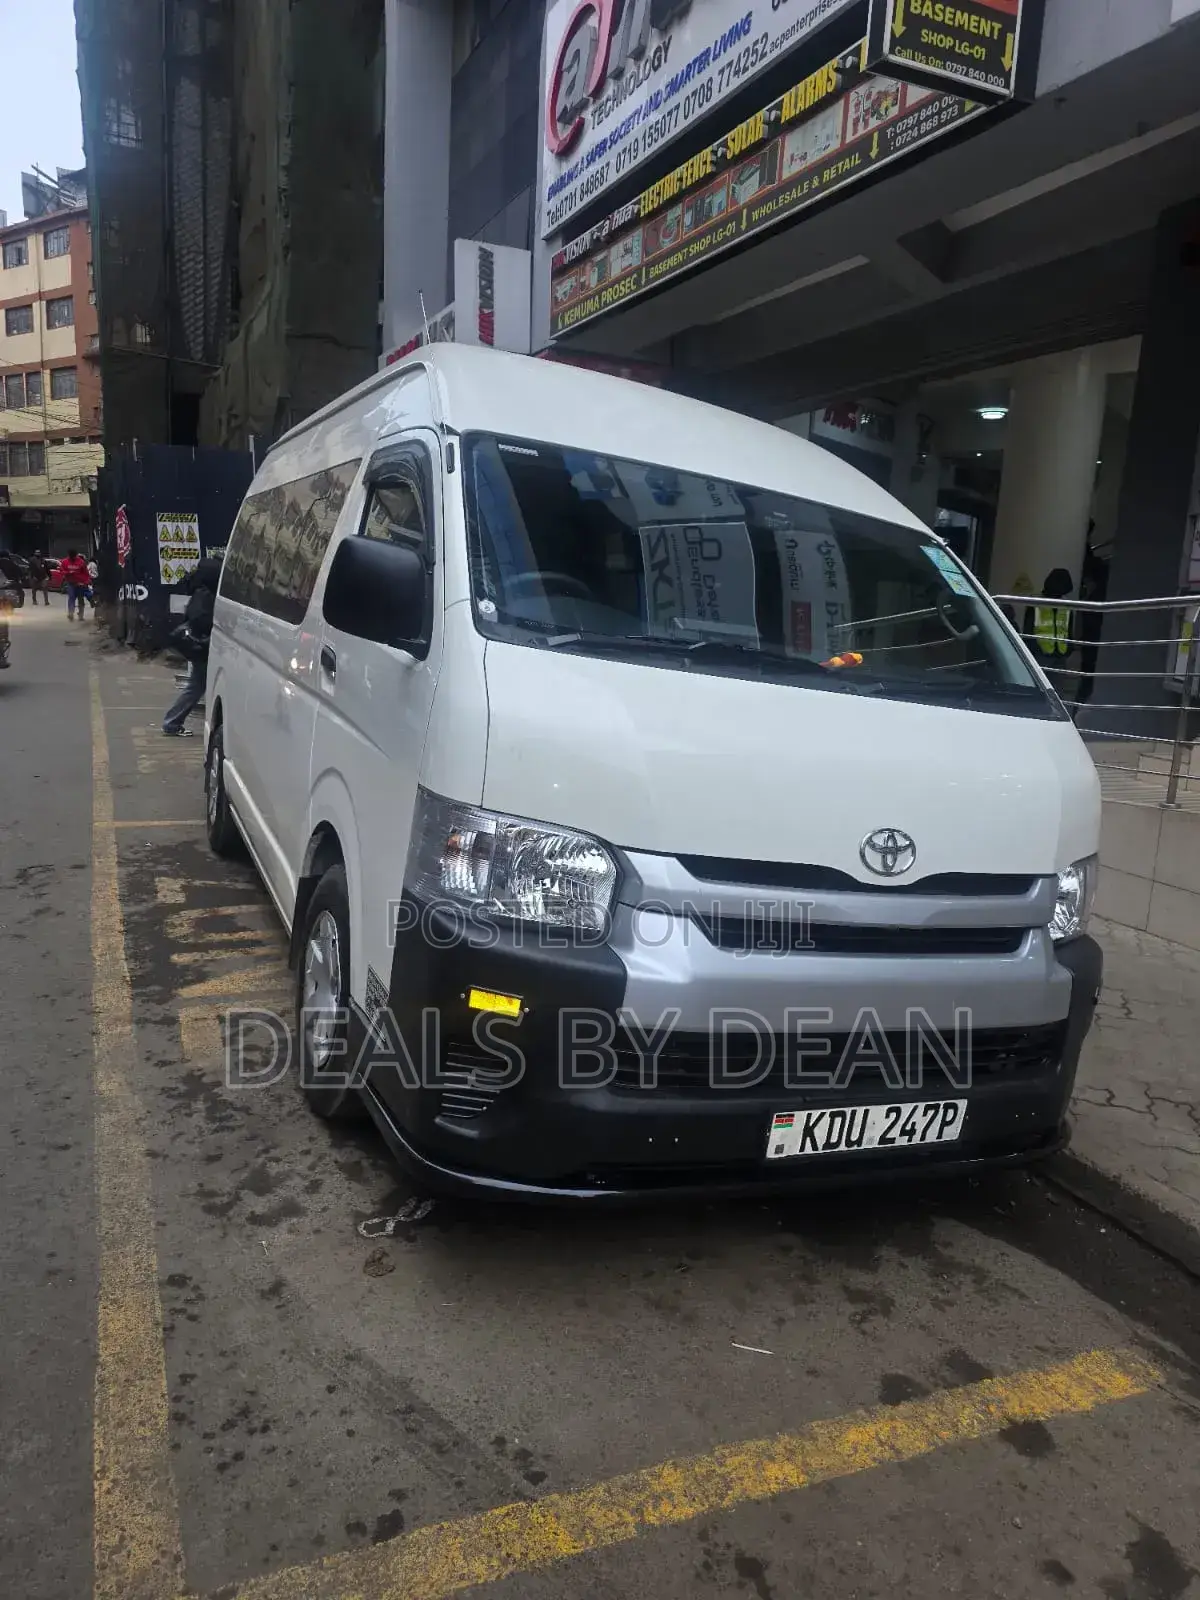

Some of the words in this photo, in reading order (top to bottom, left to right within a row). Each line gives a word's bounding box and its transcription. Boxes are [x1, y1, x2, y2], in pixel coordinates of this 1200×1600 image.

[909, 0, 1002, 40] BASEMENT
[920, 28, 954, 49] SHOP
[955, 39, 986, 61] LG-01
[591, 34, 672, 130] TECHNOLOGY
[608, 104, 643, 150] SOCIETY
[642, 89, 663, 121] AND
[663, 46, 712, 103] SMARTER
[711, 10, 753, 62] LIVING
[894, 46, 913, 59] Call
[914, 51, 926, 62] Us
[928, 55, 944, 69] On:
[945, 61, 966, 76] 0797
[968, 67, 986, 82] 840
[987, 74, 1005, 87] 000
[580, 161, 610, 202] 848687
[616, 137, 639, 174] 0719
[642, 102, 681, 152] 155077
[684, 76, 713, 121] 0708
[717, 32, 768, 93] 774252
[640, 166, 681, 218] ELECTRIC
[681, 145, 712, 190] FENCE
[726, 112, 765, 160] SOLAR
[781, 57, 839, 124] ALARMS
[896, 113, 918, 134] 0797
[919, 101, 940, 121] 840
[941, 96, 959, 107] 00
[920, 116, 938, 134] 868
[940, 104, 959, 123] 973
[564, 294, 600, 326] KEMUMA
[601, 273, 638, 308] PROSEC
[649, 248, 689, 278] BASEMENT
[688, 234, 713, 256] SHOP
[713, 221, 737, 246] LG-01
[752, 180, 810, 222] WHOLESALE
[811, 175, 820, 189] &
[822, 153, 861, 182] RETAIL
[798, 1108, 870, 1153] KDU
[877, 1101, 959, 1146] 247P
